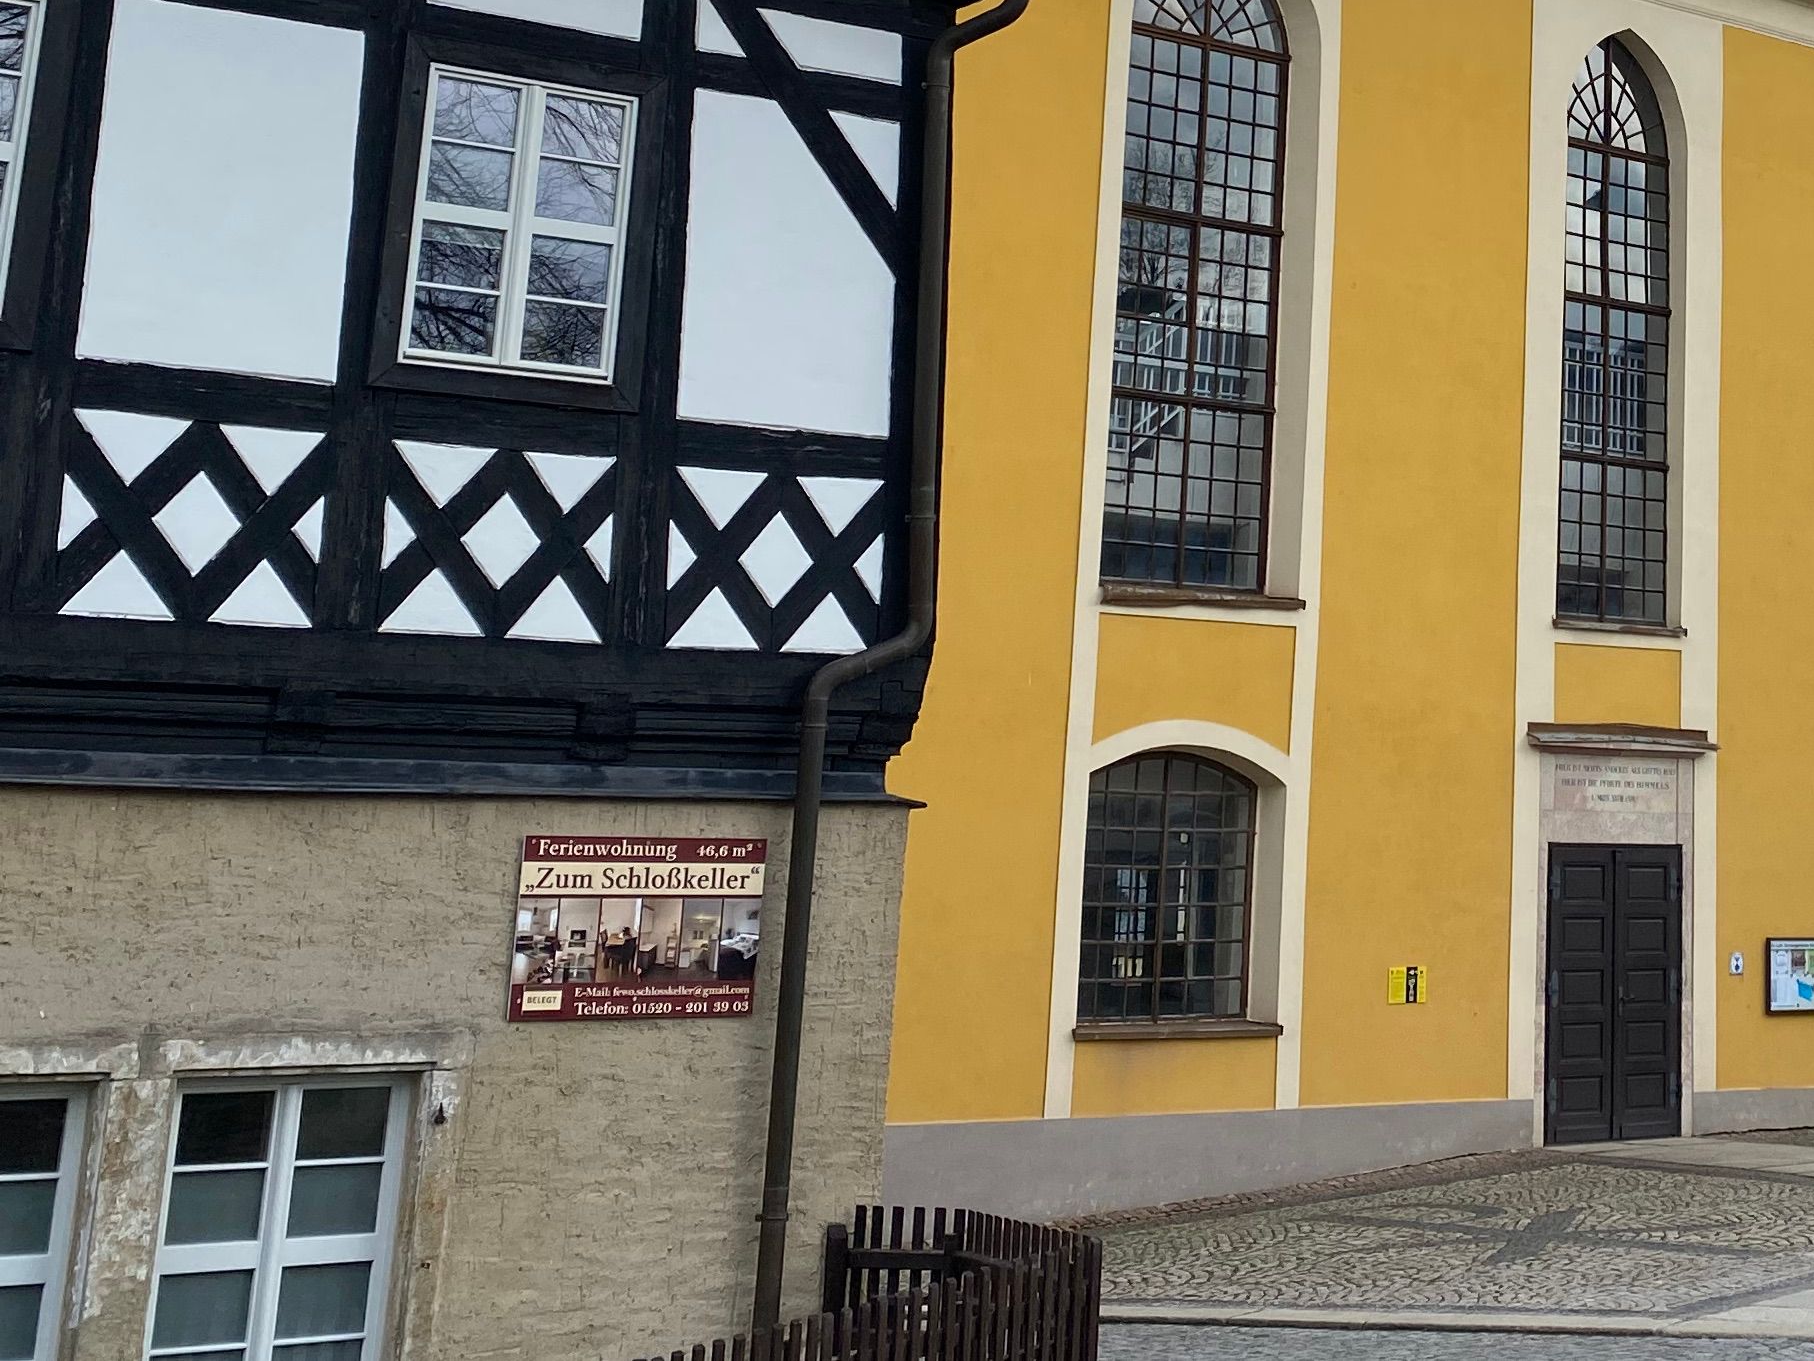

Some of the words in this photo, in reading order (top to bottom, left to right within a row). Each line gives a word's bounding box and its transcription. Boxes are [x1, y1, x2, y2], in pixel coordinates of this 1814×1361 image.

[537, 839, 677, 861] Ferienwohnung
[696, 845, 729, 858] 46,6
[732, 843, 753, 857] m²
[524, 867, 593, 893] „Zum
[600, 866, 761, 890] Schloßkeller“
[526, 995, 558, 1005] BELEGT
[574, 986, 611, 998] E-Mail:
[574, 1002, 630, 1016] Telefon:
[632, 1002, 673, 1014] 01520
[685, 1001, 708, 1013] 201
[712, 1001, 730, 1013] 39
[732, 1000, 750, 1012] 03
